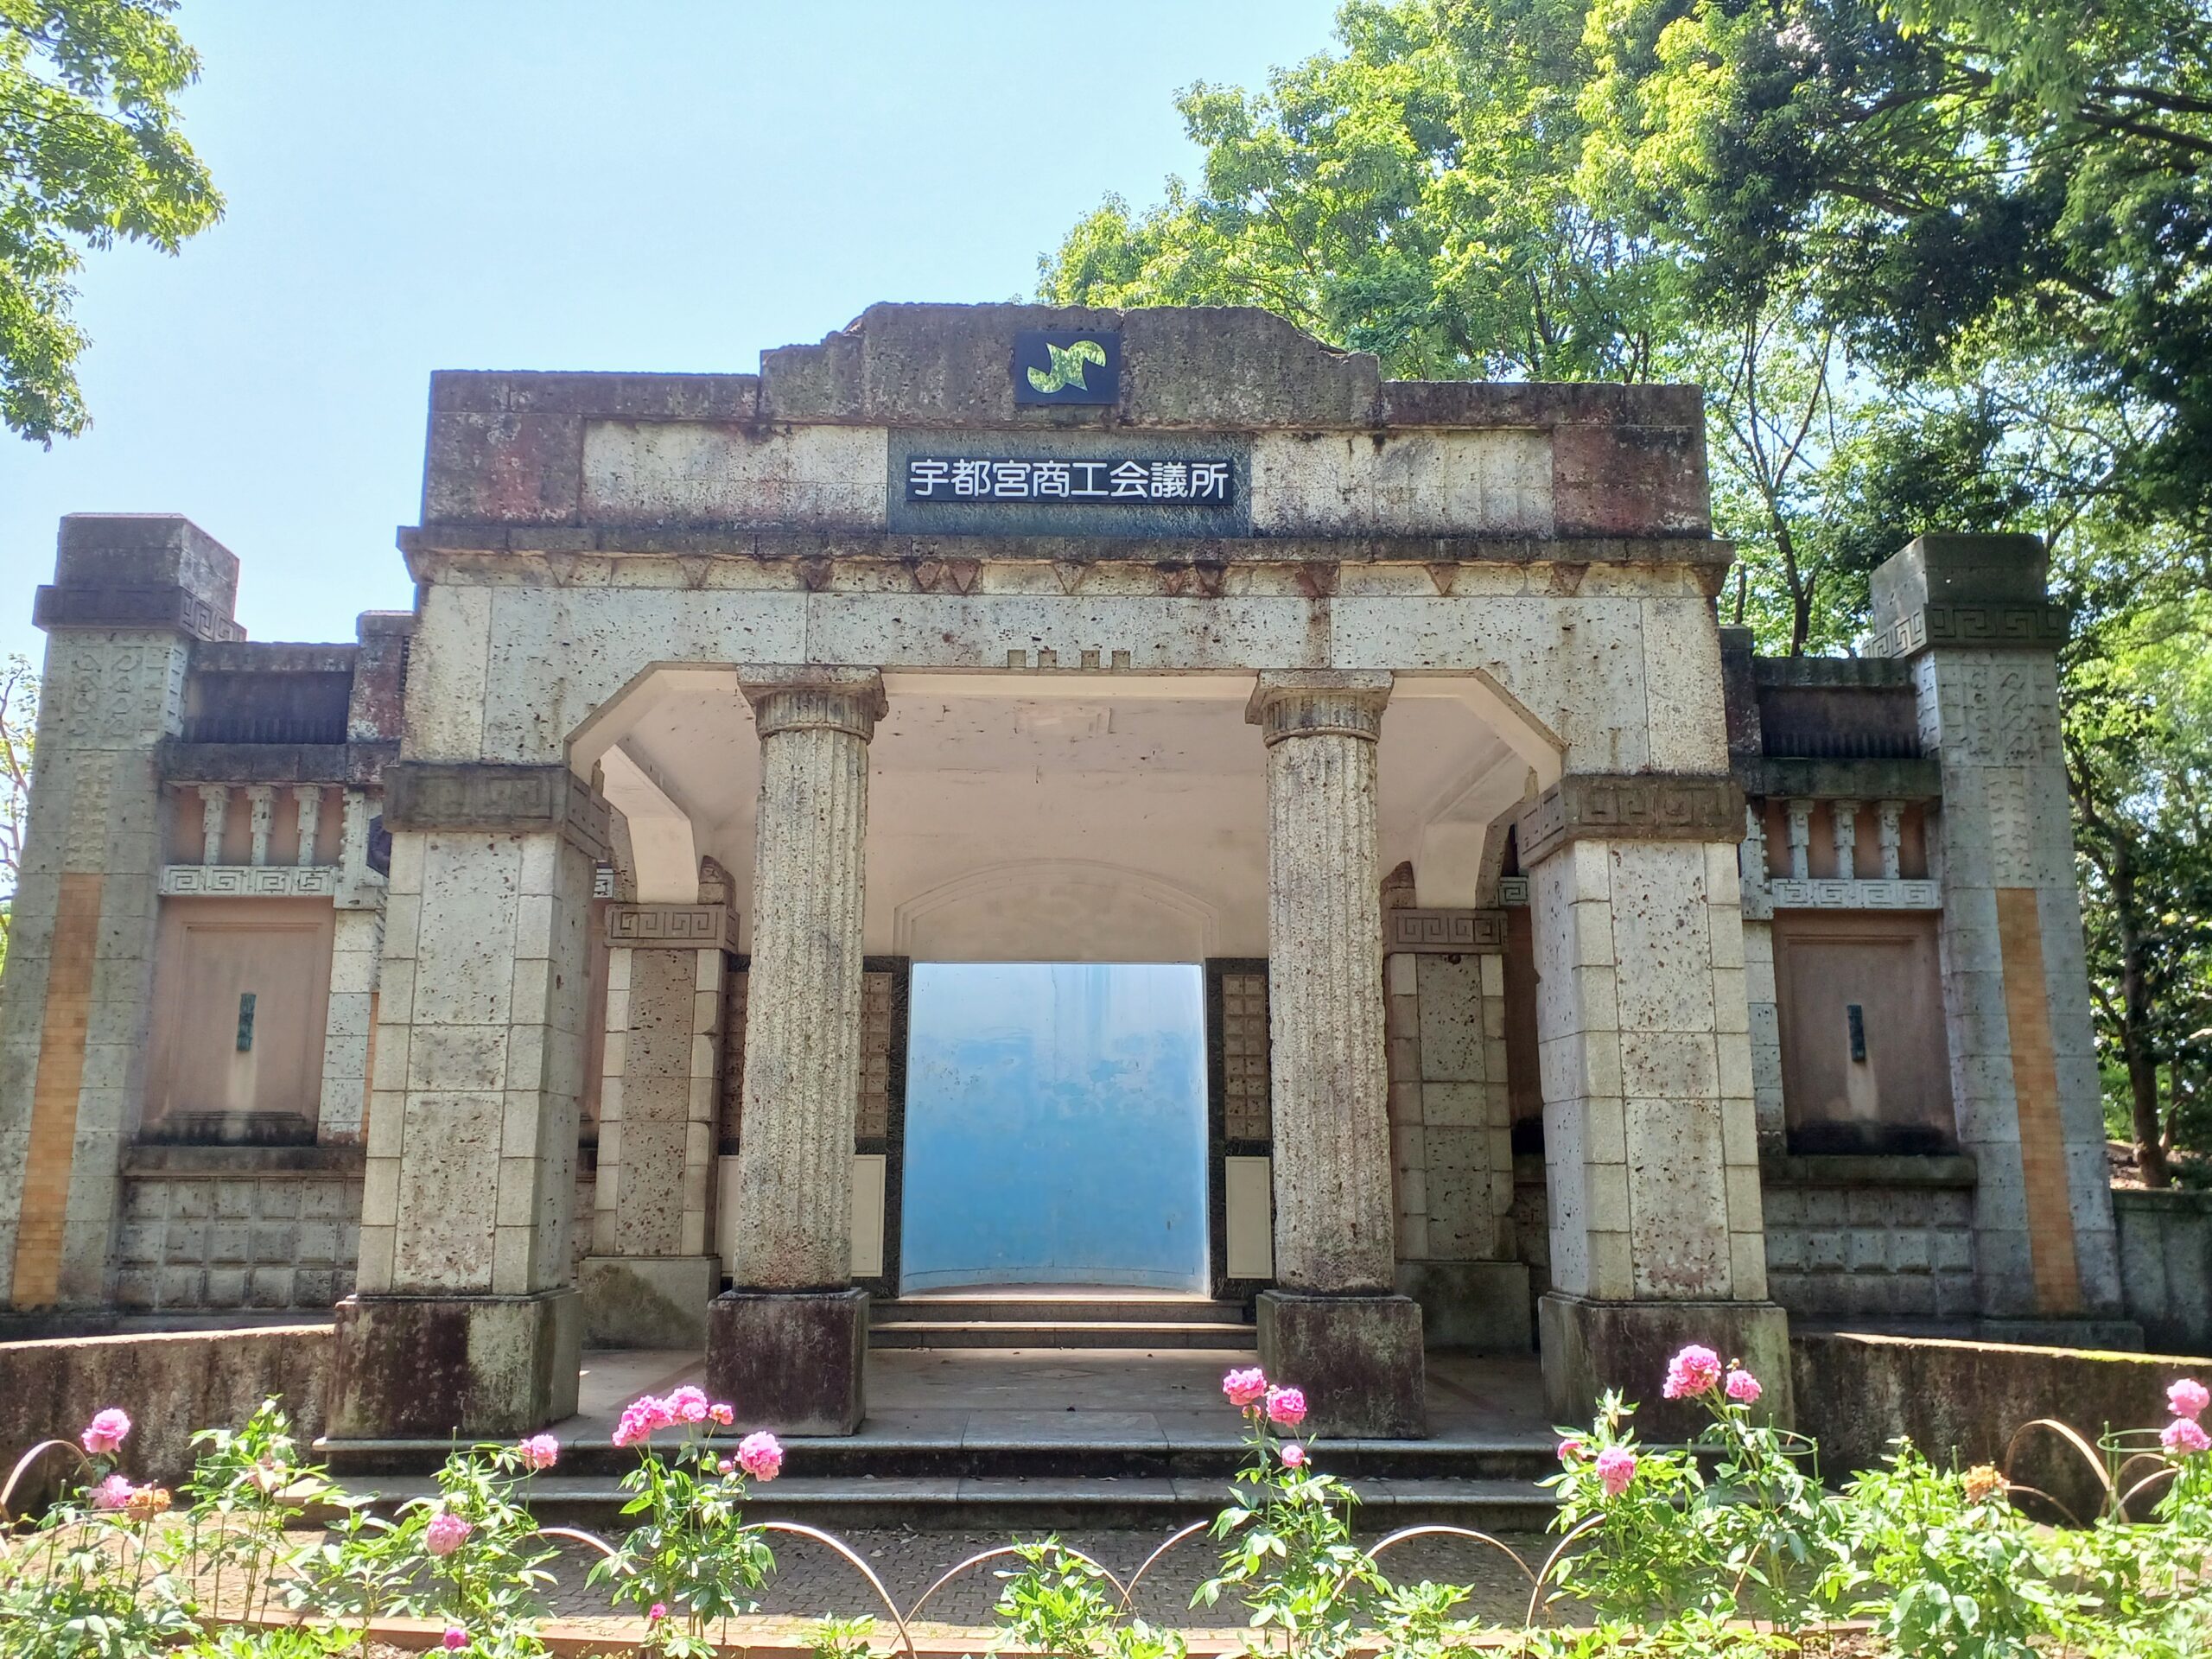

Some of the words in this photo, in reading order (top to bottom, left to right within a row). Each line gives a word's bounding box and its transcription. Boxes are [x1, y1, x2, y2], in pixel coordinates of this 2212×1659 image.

[909, 459, 1230, 499] 宇都宮商工会議所
